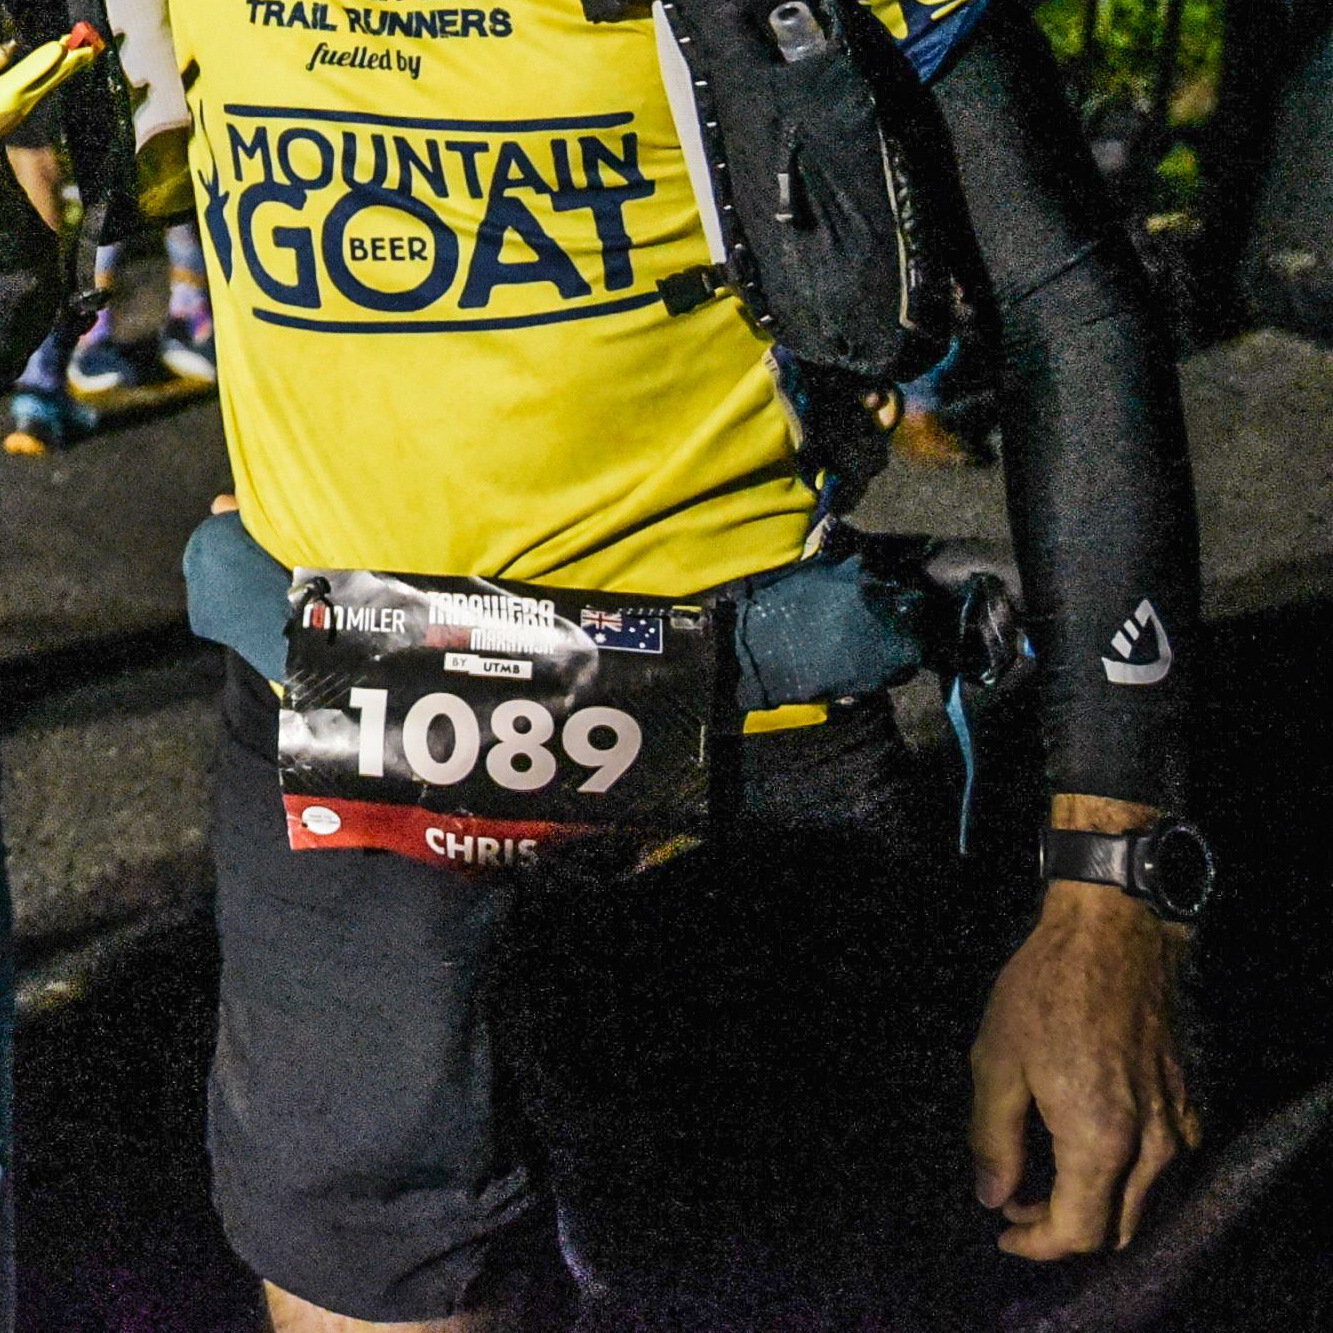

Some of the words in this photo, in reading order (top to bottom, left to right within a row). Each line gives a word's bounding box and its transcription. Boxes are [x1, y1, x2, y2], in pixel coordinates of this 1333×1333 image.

[348, 5, 513, 38] RUNNERS
[306, 42, 392, 72] fuelled
[396, 50, 421, 79] by
[226, 122, 639, 199] MOUNTAIN
[237, 169, 655, 312] GOAT
[349, 236, 428, 262] BEER
[346, 606, 406, 633] MILER
[452, 657, 468, 668] BY
[483, 662, 521, 675] UTMB
[349, 686, 642, 794] 1089
[425, 827, 538, 865] CHRIS
